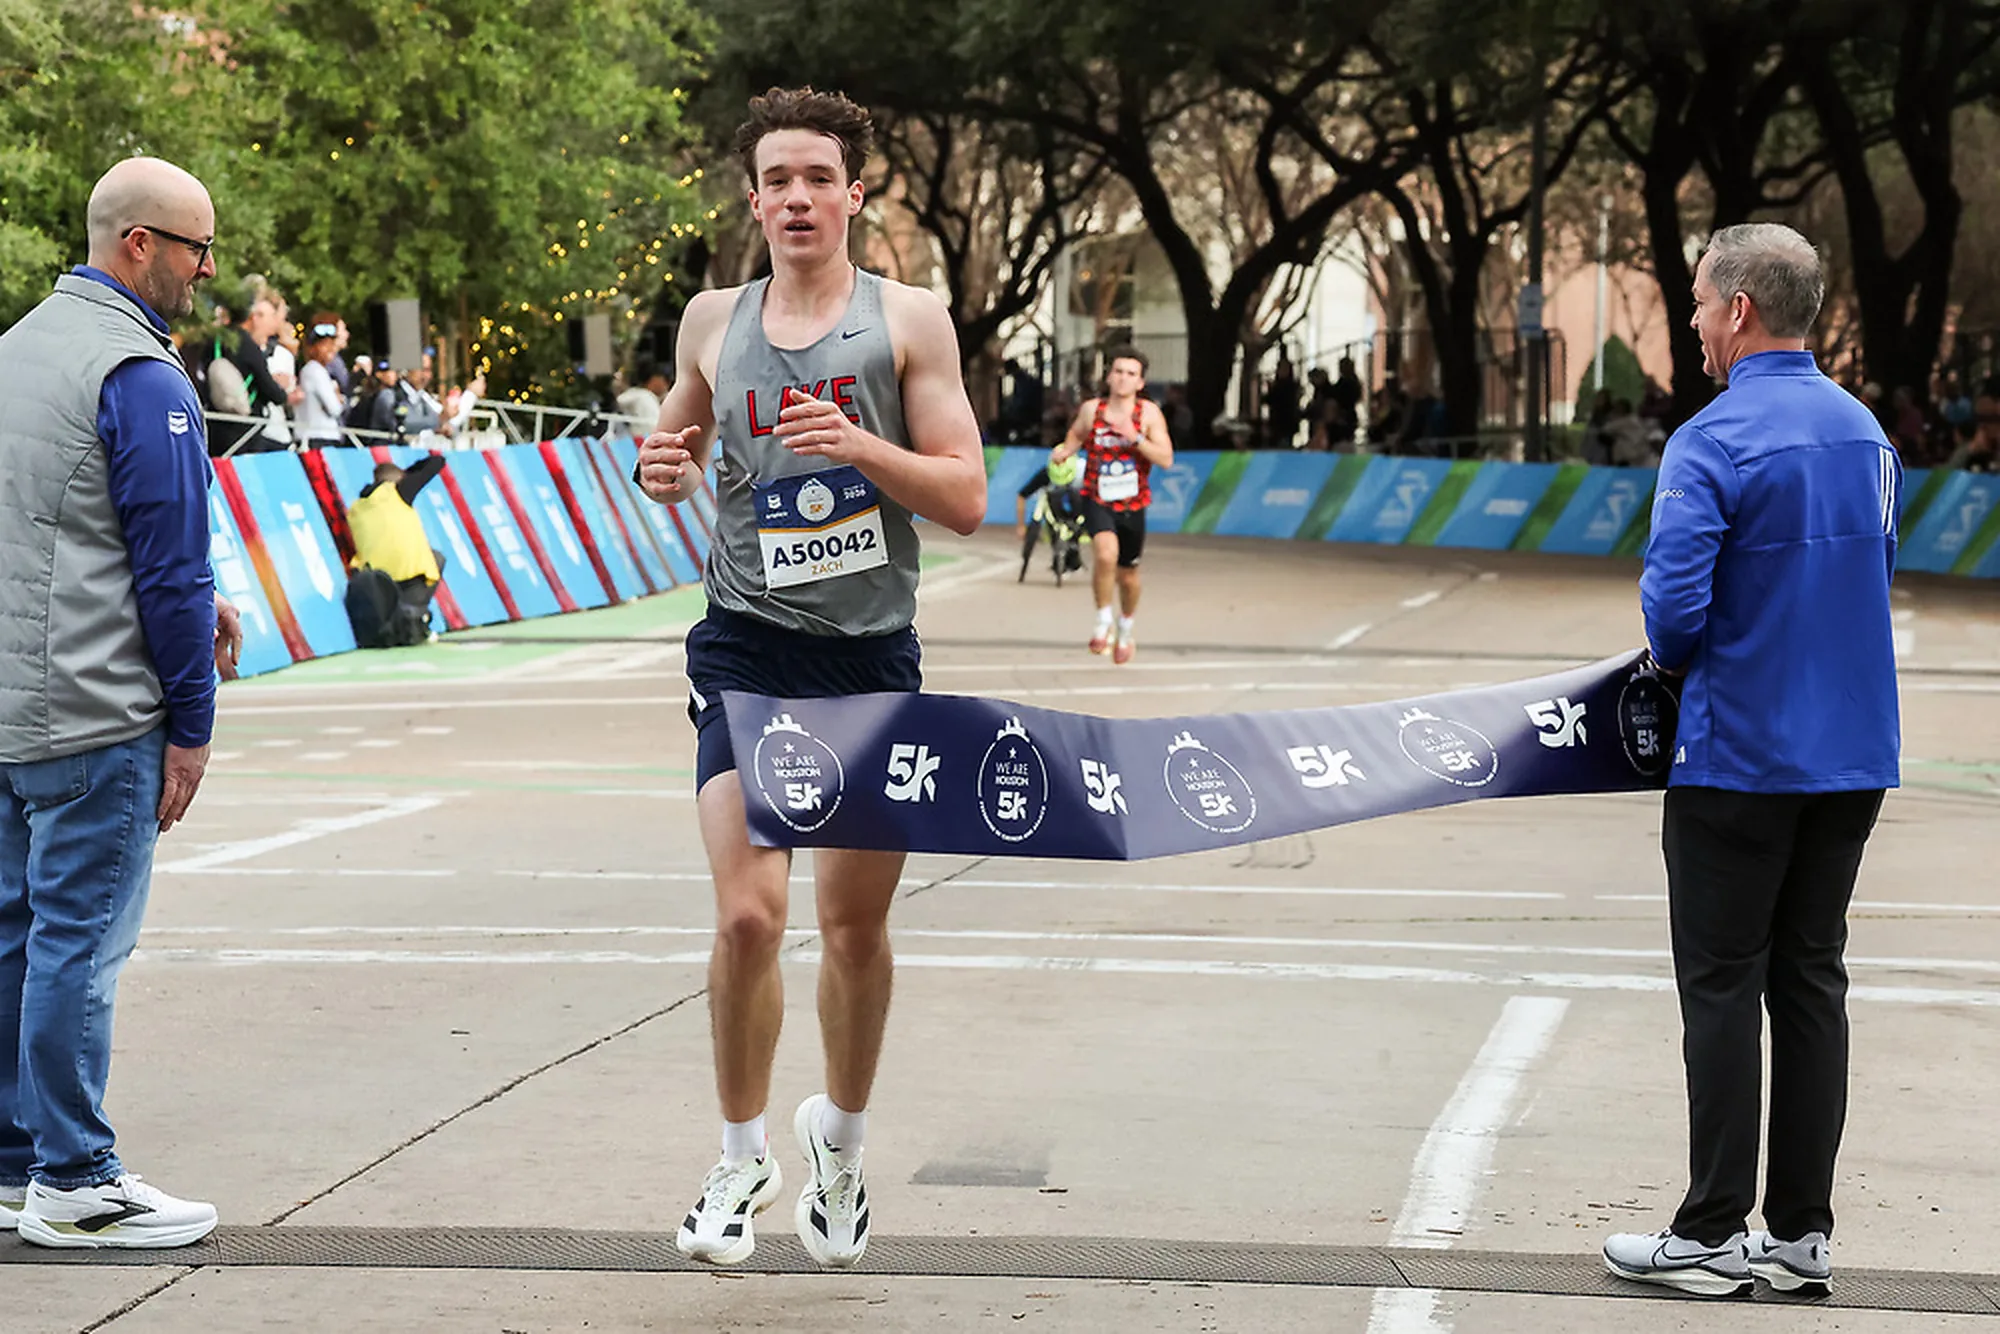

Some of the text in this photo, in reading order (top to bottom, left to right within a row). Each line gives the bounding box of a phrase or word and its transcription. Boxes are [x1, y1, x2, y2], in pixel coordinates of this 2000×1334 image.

[772, 528, 877, 569] A50042
[811, 560, 844, 576] ZACH
[771, 755, 818, 768] WE ARE
[995, 762, 1029, 775] WE ARE
[995, 776, 1029, 786] HOUSTON
